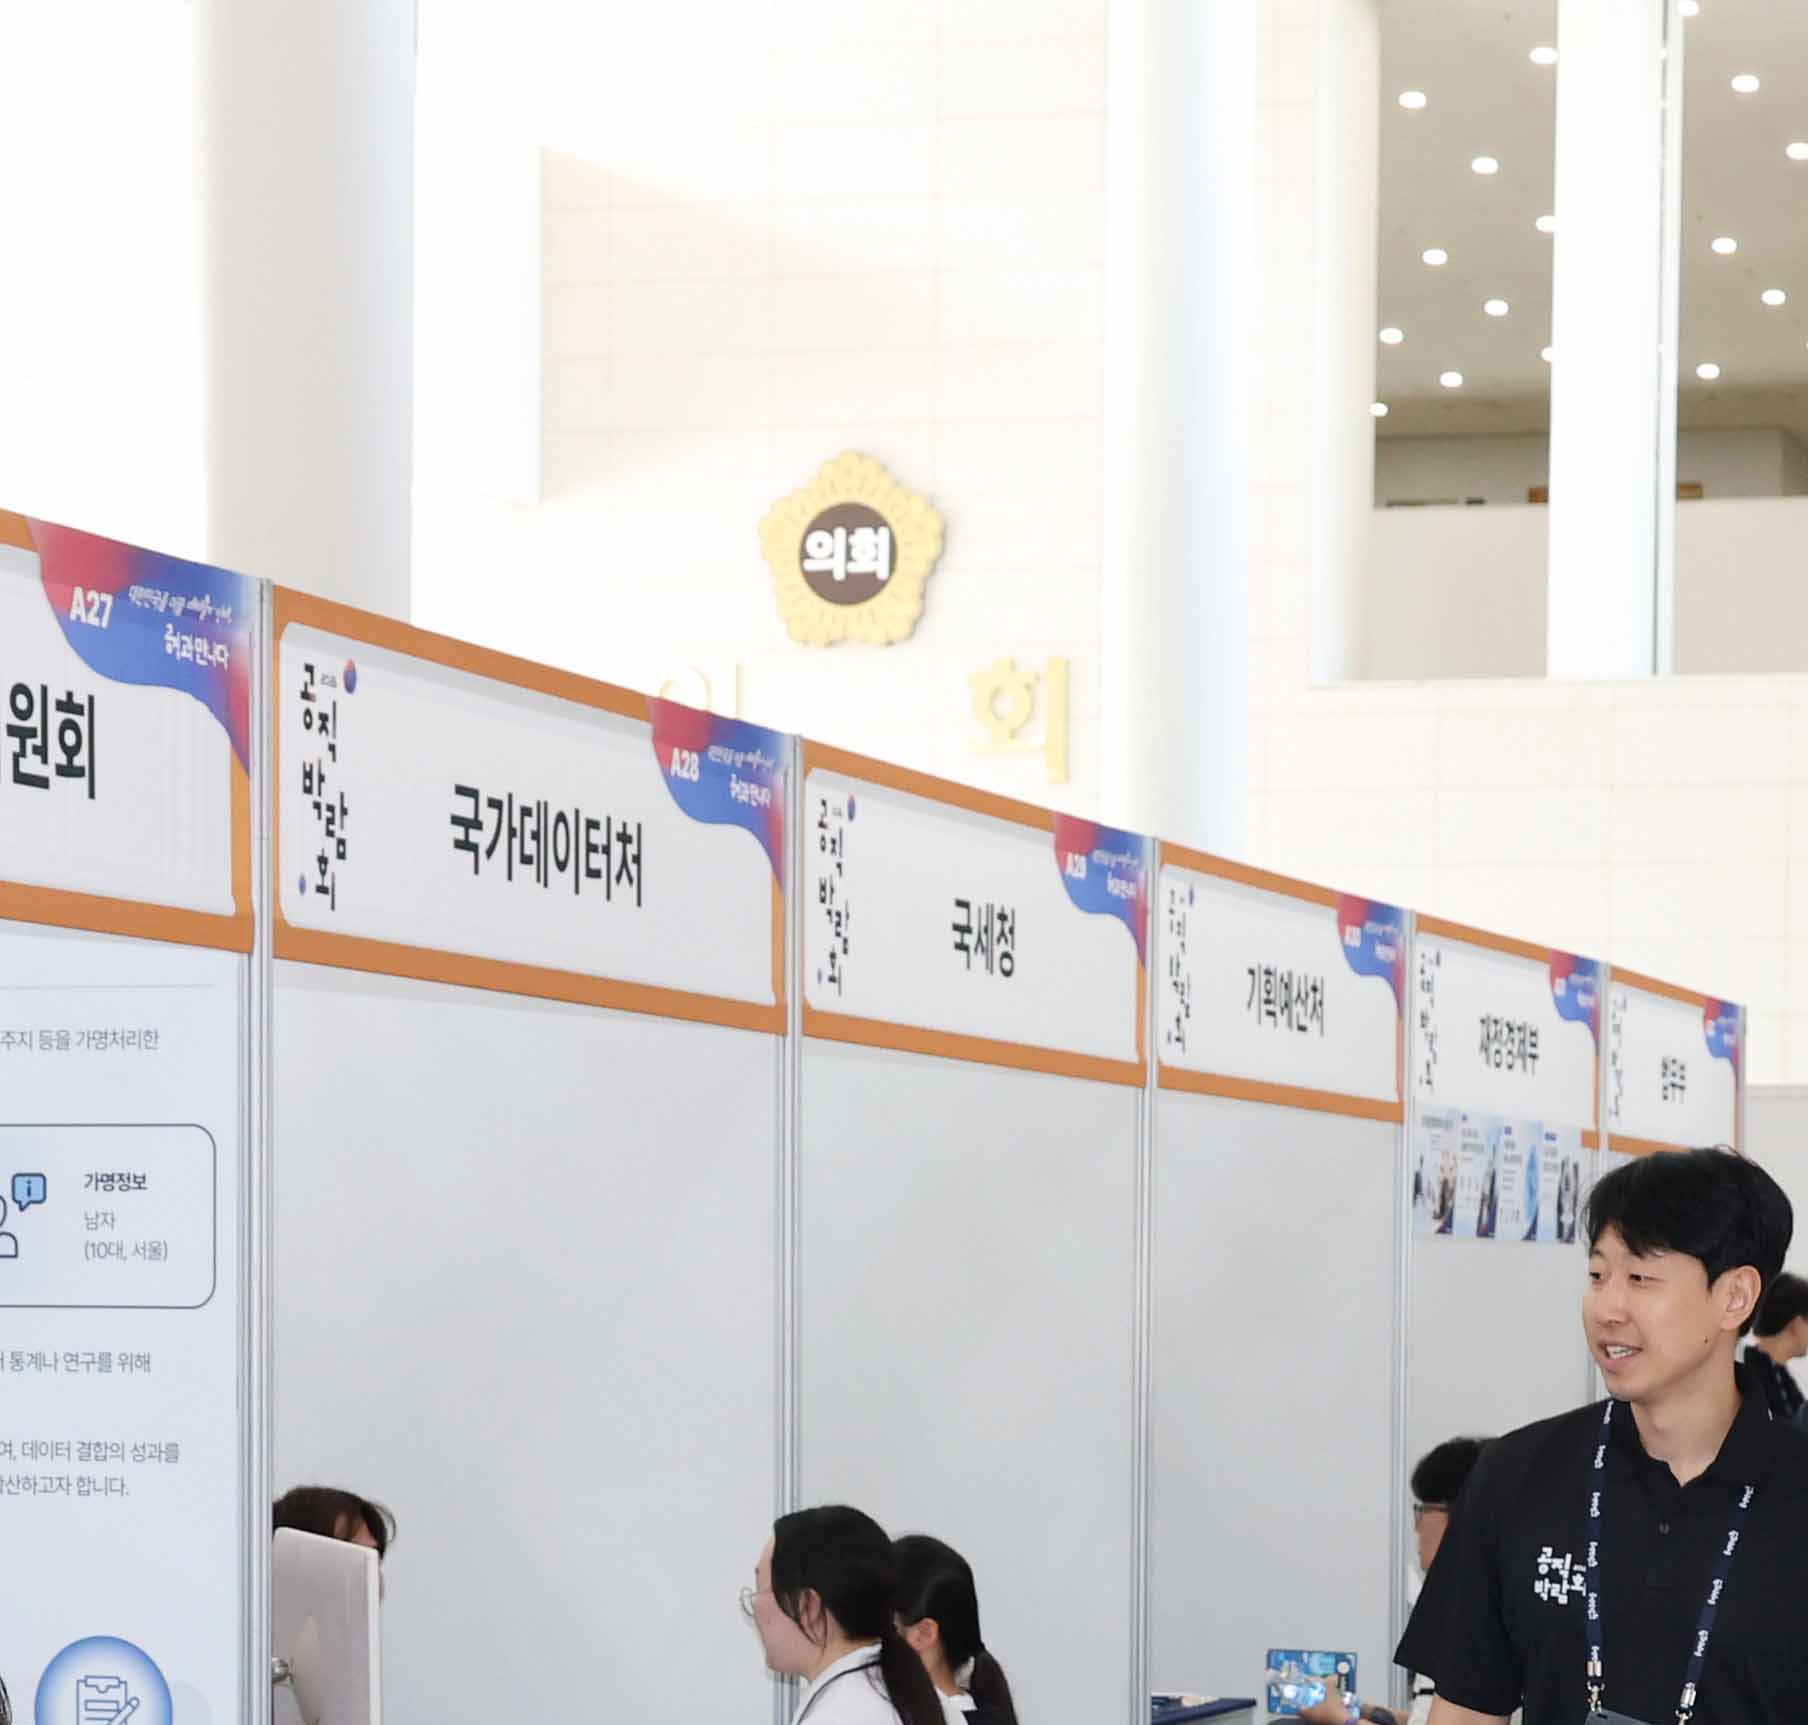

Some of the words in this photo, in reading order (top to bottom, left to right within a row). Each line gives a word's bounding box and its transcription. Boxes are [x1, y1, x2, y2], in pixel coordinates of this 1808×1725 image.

[802, 525, 892, 581] 의회
[69, 586, 113, 629] A27
[670, 746, 700, 783] A28
[450, 783, 642, 908] 국가데이터처
[952, 897, 1016, 978] 국세청
[1247, 962, 1325, 1037] 기획예산처
[38, 1029, 71, 1051] 등을
[76, 1029, 160, 1051] 가명처리한
[1479, 1014, 1539, 1075] 재정경제부
[83, 1172, 148, 1192] 가명정보
[83, 1210, 116, 1231] 남자
[83, 1239, 128, 1262] (10대,
[131, 1239, 169, 1262] 서울)
[9, 1350, 60, 1373] 통계나
[63, 1351, 114, 1373] 연구를
[117, 1351, 152, 1374] 위해
[21, 1440, 72, 1462] 데이터
[77, 1440, 126, 1462] 결합의
[129, 1441, 181, 1463] 성과를
[76, 1475, 131, 1497] 합니다.
[1536, 1546, 1572, 1579] 공직
[1534, 1573, 1586, 1605] 박람회
